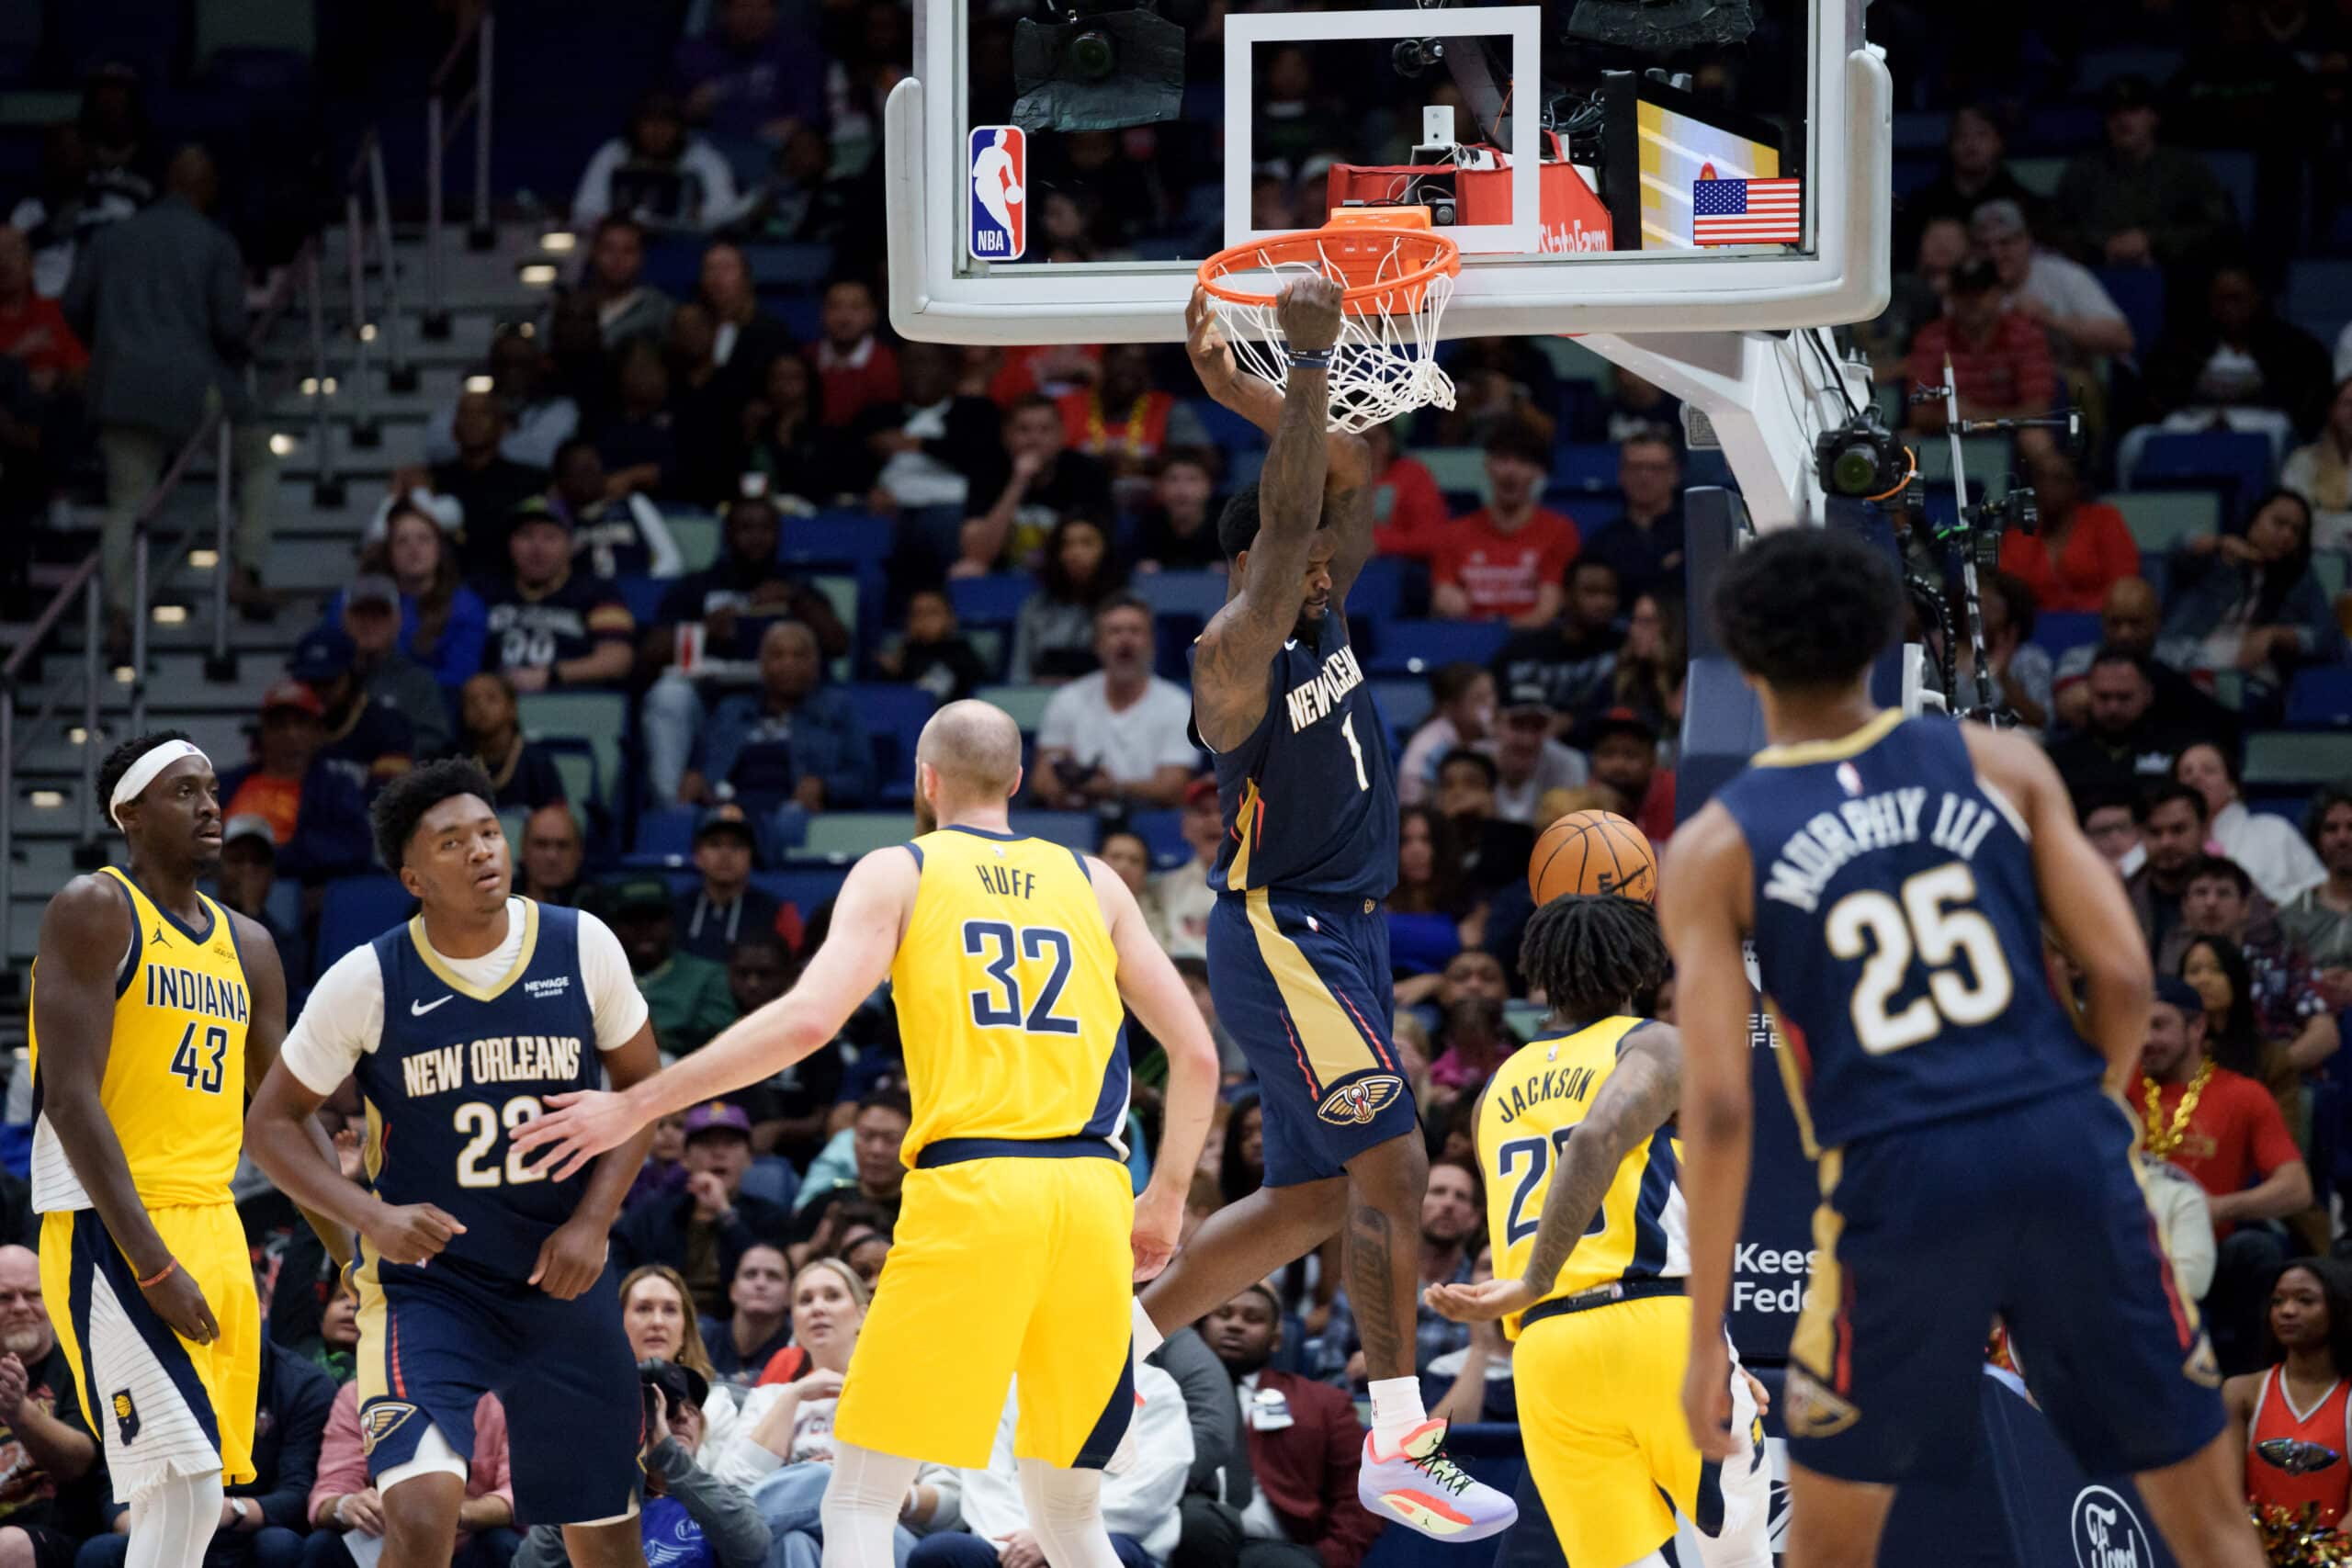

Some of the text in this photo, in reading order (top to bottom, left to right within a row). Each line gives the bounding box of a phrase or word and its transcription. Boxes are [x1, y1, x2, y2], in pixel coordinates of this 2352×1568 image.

[978, 230, 1004, 251] NBA
[1286, 673, 1331, 735] NEW
[1341, 711, 1370, 792] 1
[976, 864, 1035, 900] HUFF
[1763, 785, 1997, 913] MURPHY III
[525, 976, 570, 993] NEWAGE
[963, 919, 1080, 1036] 32
[1825, 861, 2014, 1056] 25
[146, 964, 249, 1026] INDIANA
[169, 1021, 228, 1095] 43
[402, 1036, 582, 1098] NEW ORLEANS
[1498, 1066, 1596, 1123] JACKSON
[453, 1095, 548, 1188] 22
[1498, 1121, 1606, 1248] 2
